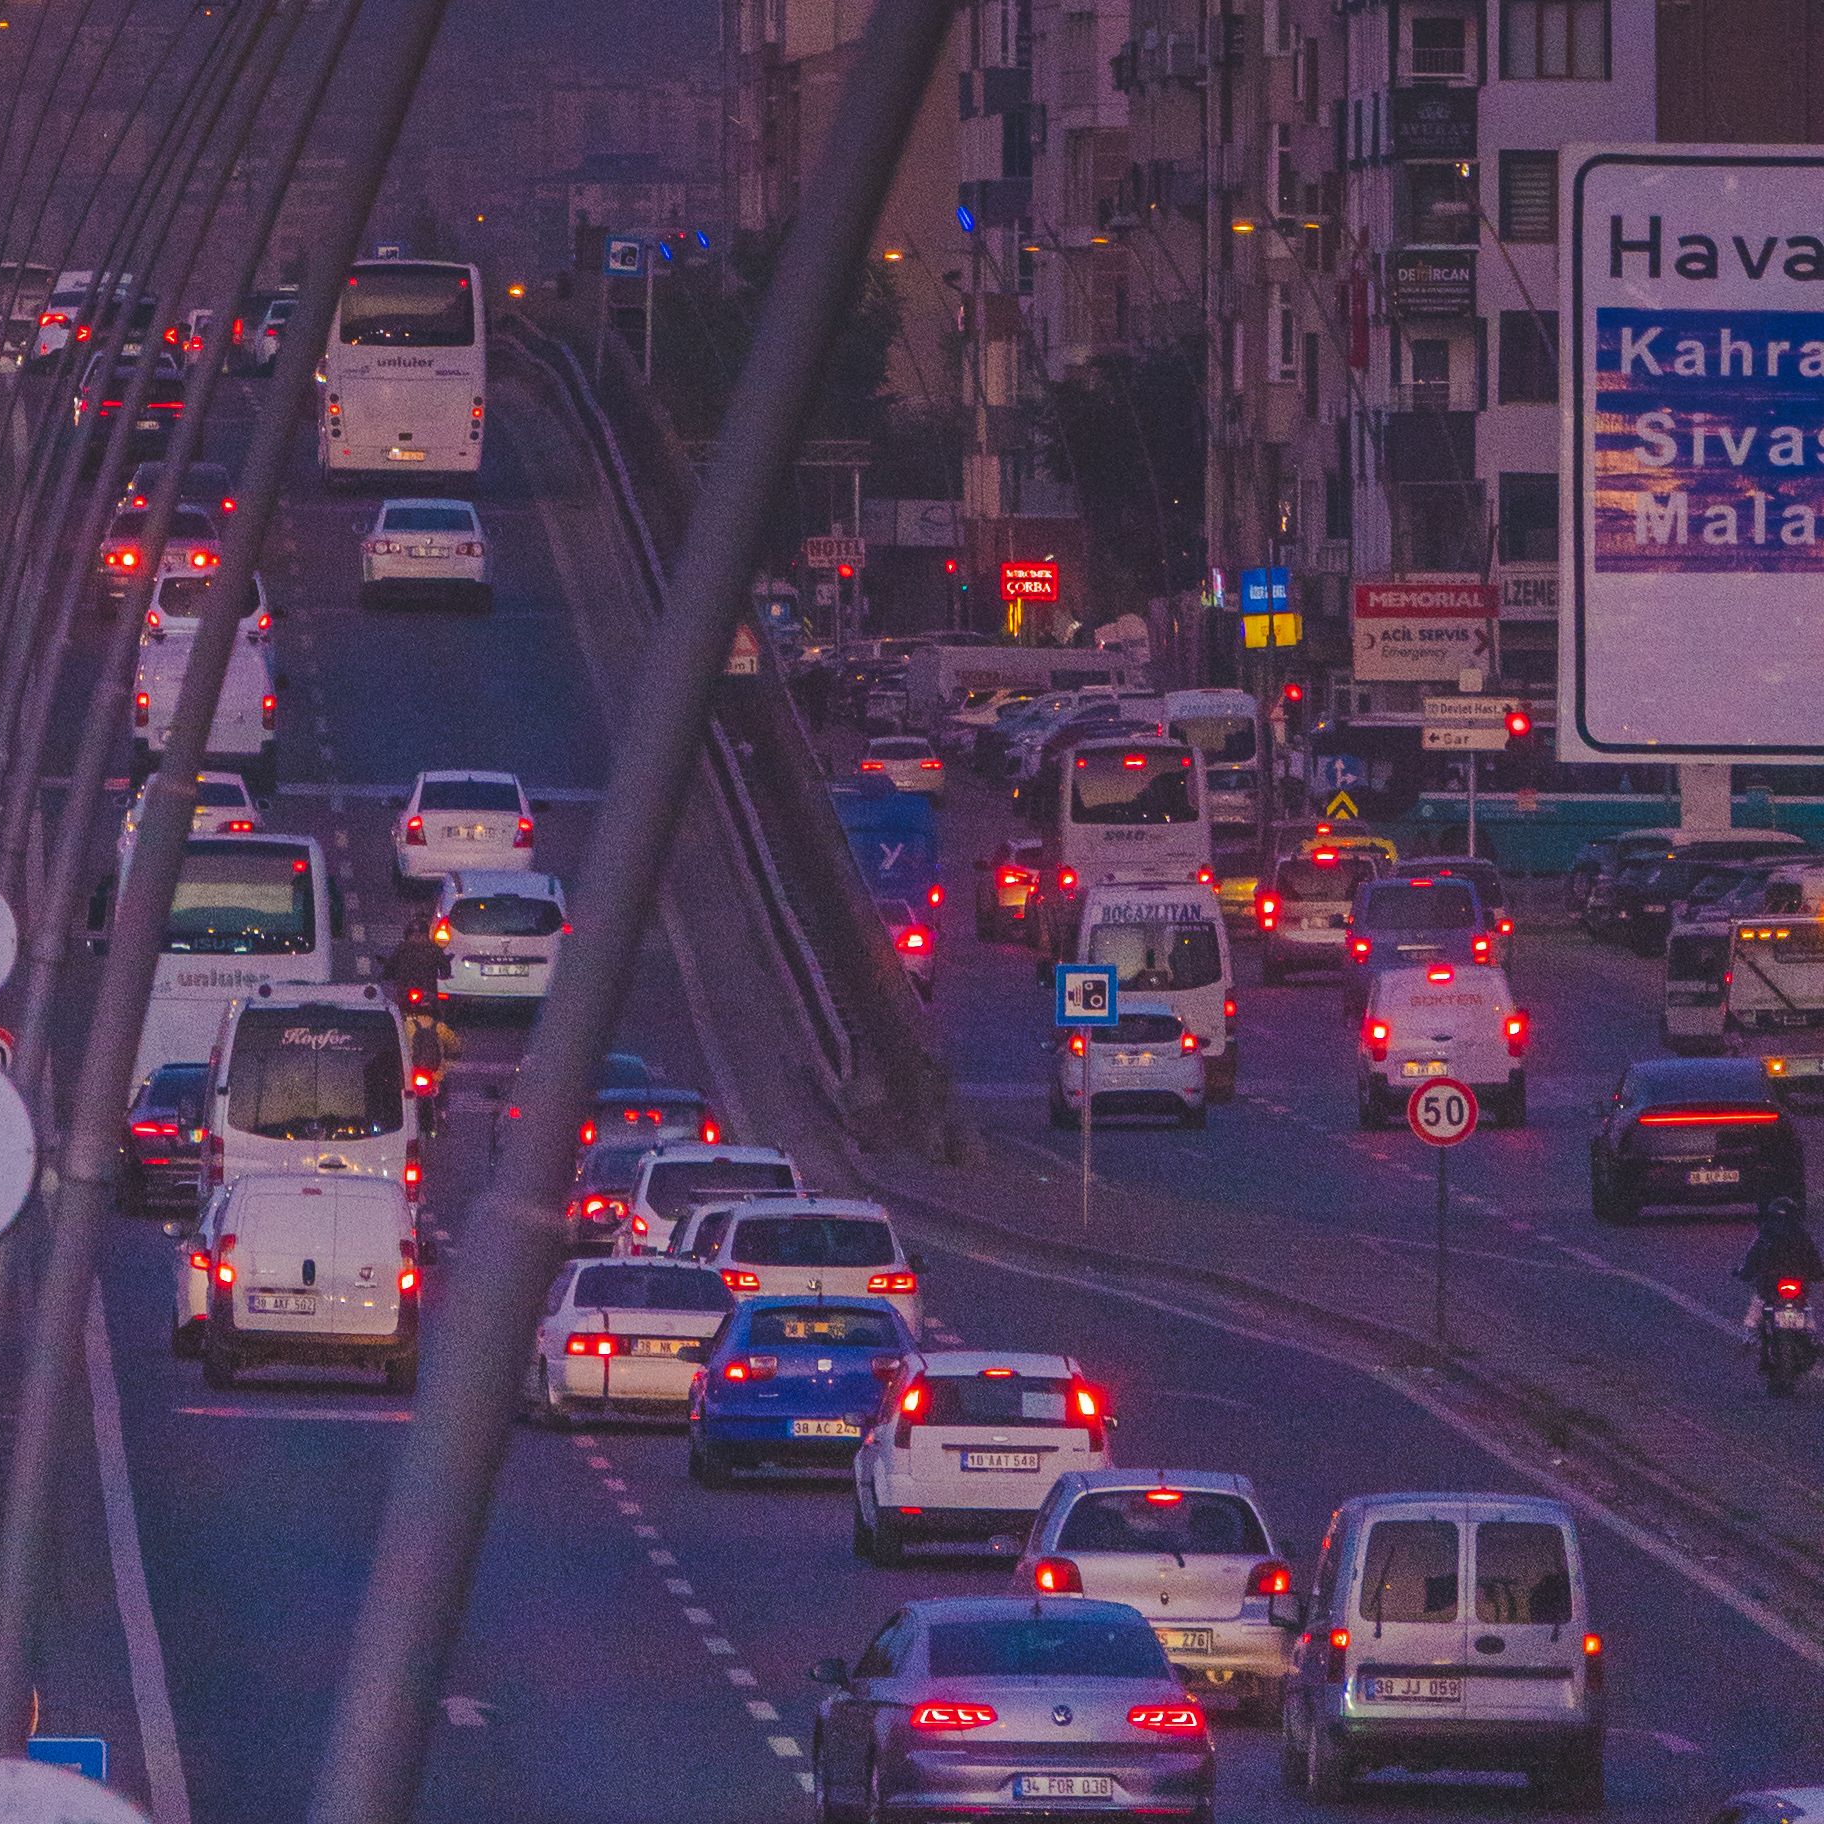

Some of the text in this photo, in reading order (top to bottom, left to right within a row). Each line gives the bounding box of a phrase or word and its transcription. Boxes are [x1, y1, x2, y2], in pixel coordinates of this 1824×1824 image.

[1610, 215, 1824, 281] Hava
[1621, 327, 1824, 377] Kahra
[1635, 412, 1824, 467] Siva
[1635, 490, 1816, 546] Mala
[1006, 581, 1051, 595] ÇORBA
[1369, 591, 1484, 608] MEMORIAL
[1382, 645, 1448, 662] Emergency
[1443, 732, 1469, 745] Gar
[1423, 1095, 1465, 1127] 50
[1181, 1632, 1206, 1647] 276
